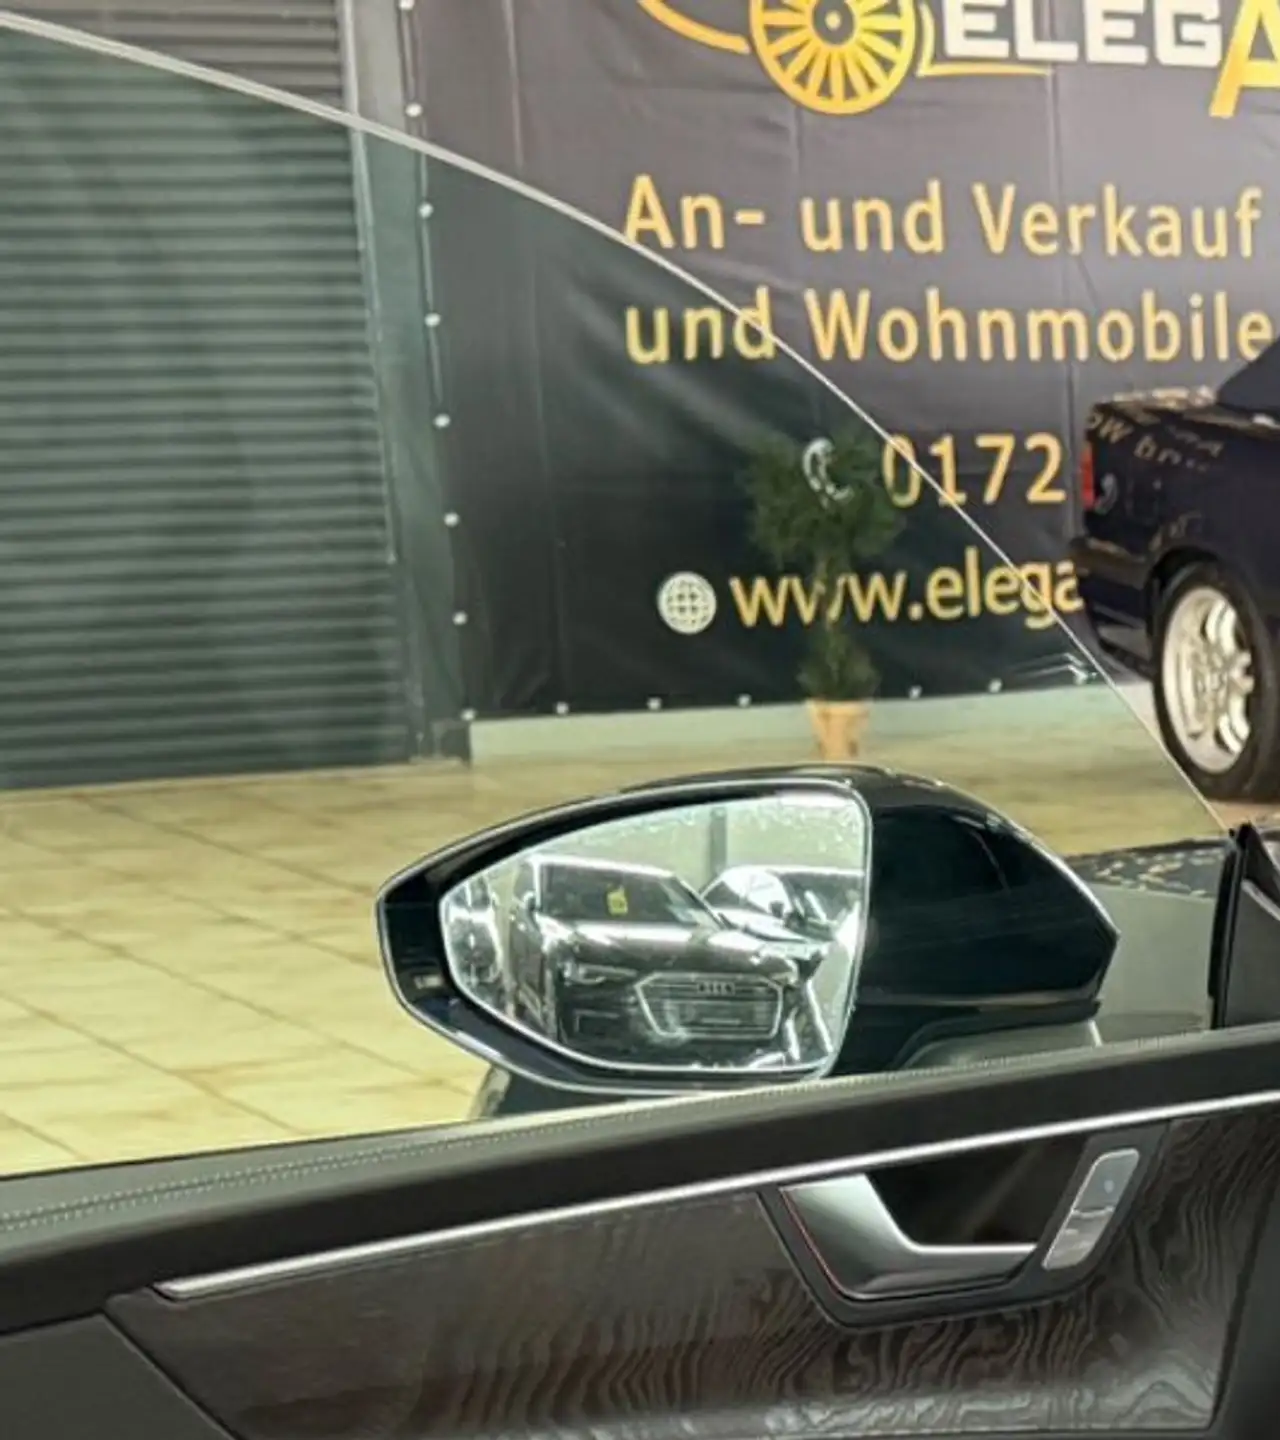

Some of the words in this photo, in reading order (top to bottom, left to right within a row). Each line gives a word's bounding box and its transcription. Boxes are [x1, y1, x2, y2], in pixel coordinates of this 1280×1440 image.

[624, 174, 765, 249] An-
[800, 179, 944, 252] und
[972, 183, 1262, 258] Verkauf
[625, 285, 774, 364] und
[803, 286, 1274, 362] Wohnmobile
[881, 432, 1066, 505] 0172
[729, 547, 1083, 629] www.elega
